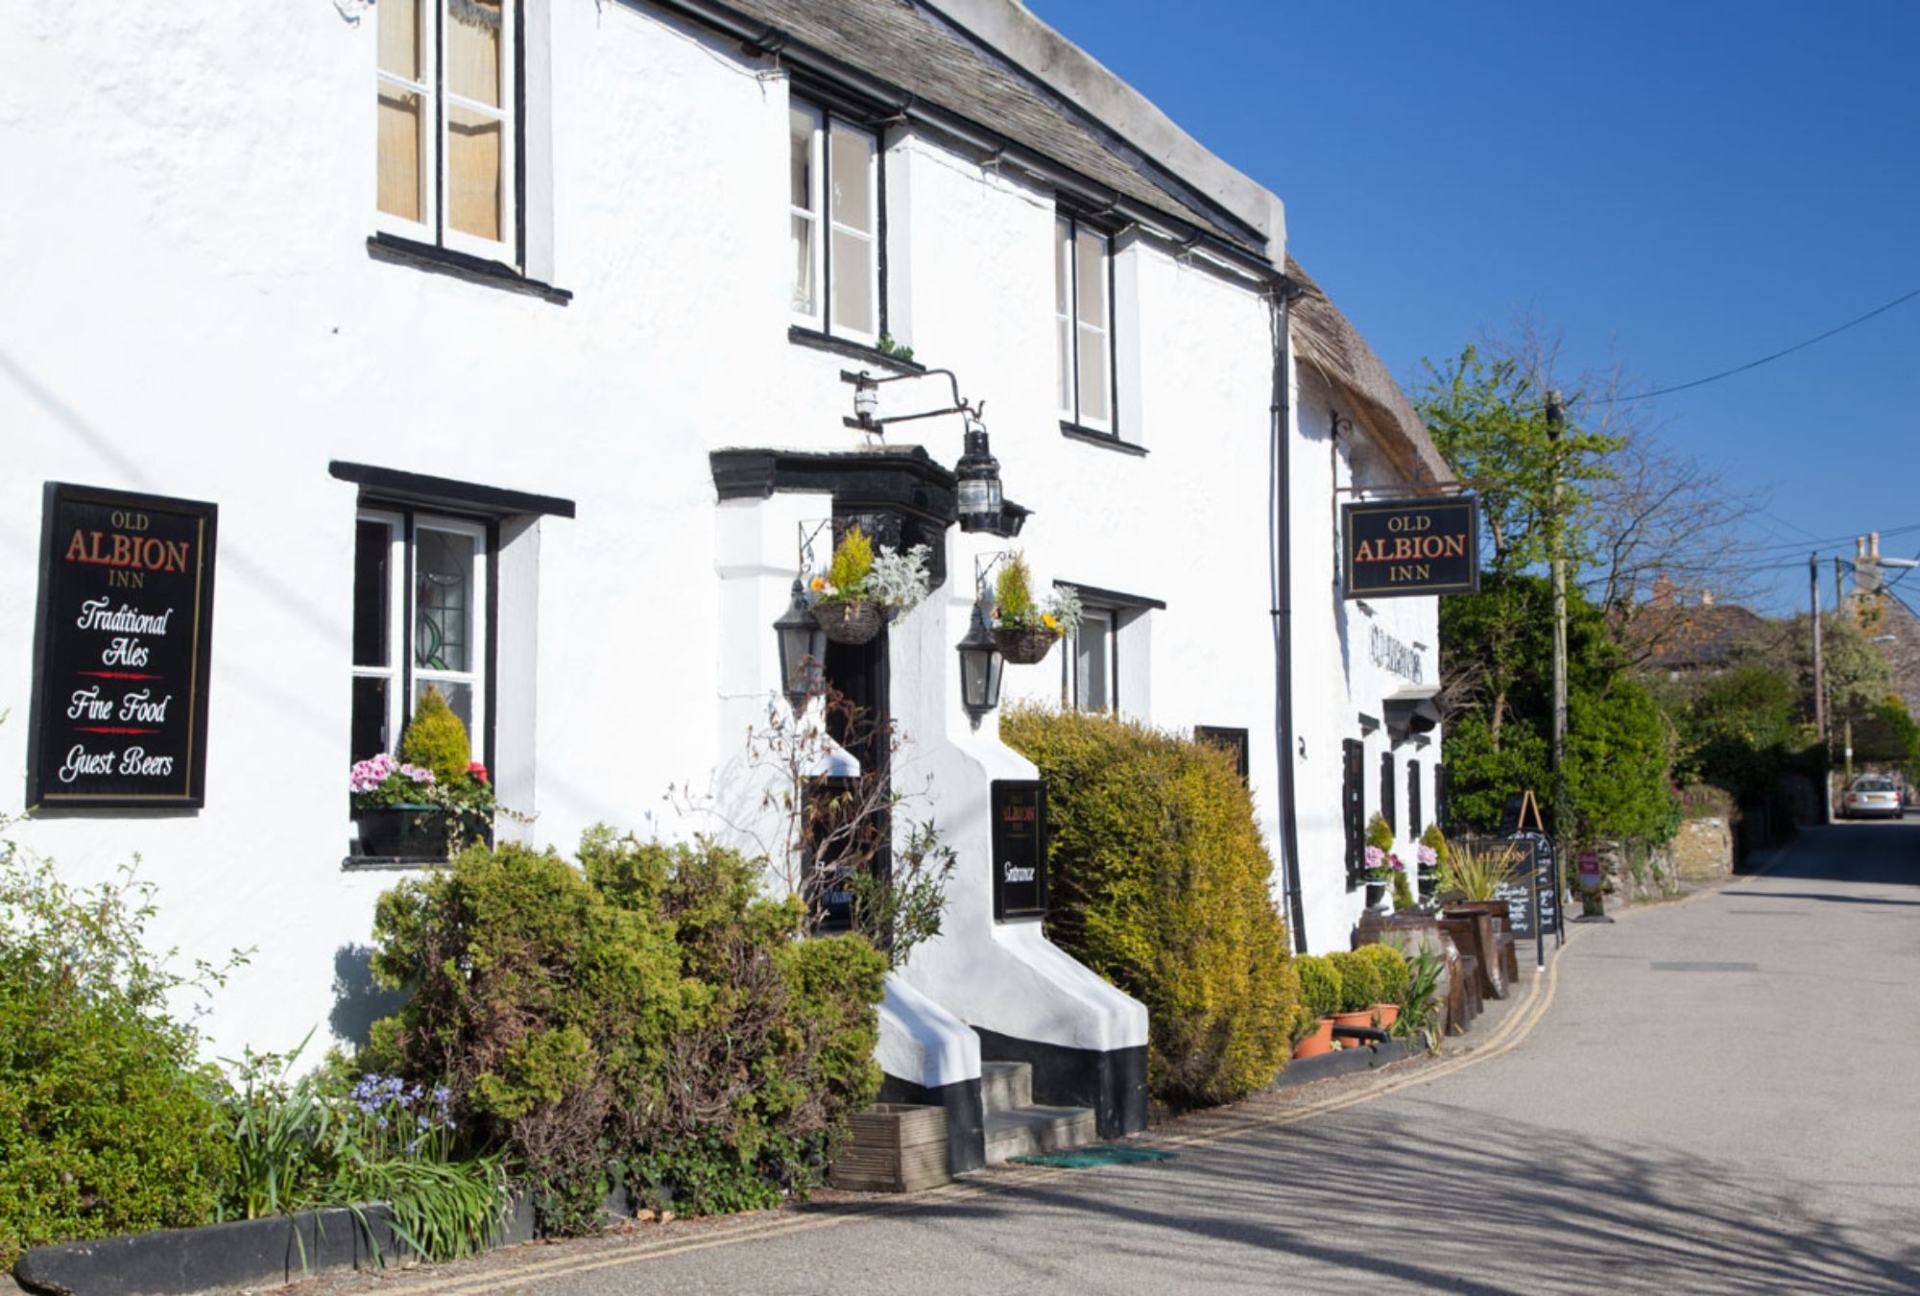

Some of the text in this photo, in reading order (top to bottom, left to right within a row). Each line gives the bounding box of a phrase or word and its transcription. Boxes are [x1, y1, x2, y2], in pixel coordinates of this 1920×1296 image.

[111, 510, 149, 531] OLD
[1387, 515, 1431, 533] OLD
[65, 529, 190, 574] ALBION
[1354, 533, 1466, 562] ALBION
[108, 570, 145, 589] INN
[1389, 564, 1430, 582] INN
[77, 596, 173, 636] Traditional
[102, 637, 149, 668] Ales
[67, 685, 172, 723] Fine Food
[58, 744, 173, 783] Guest Beers
